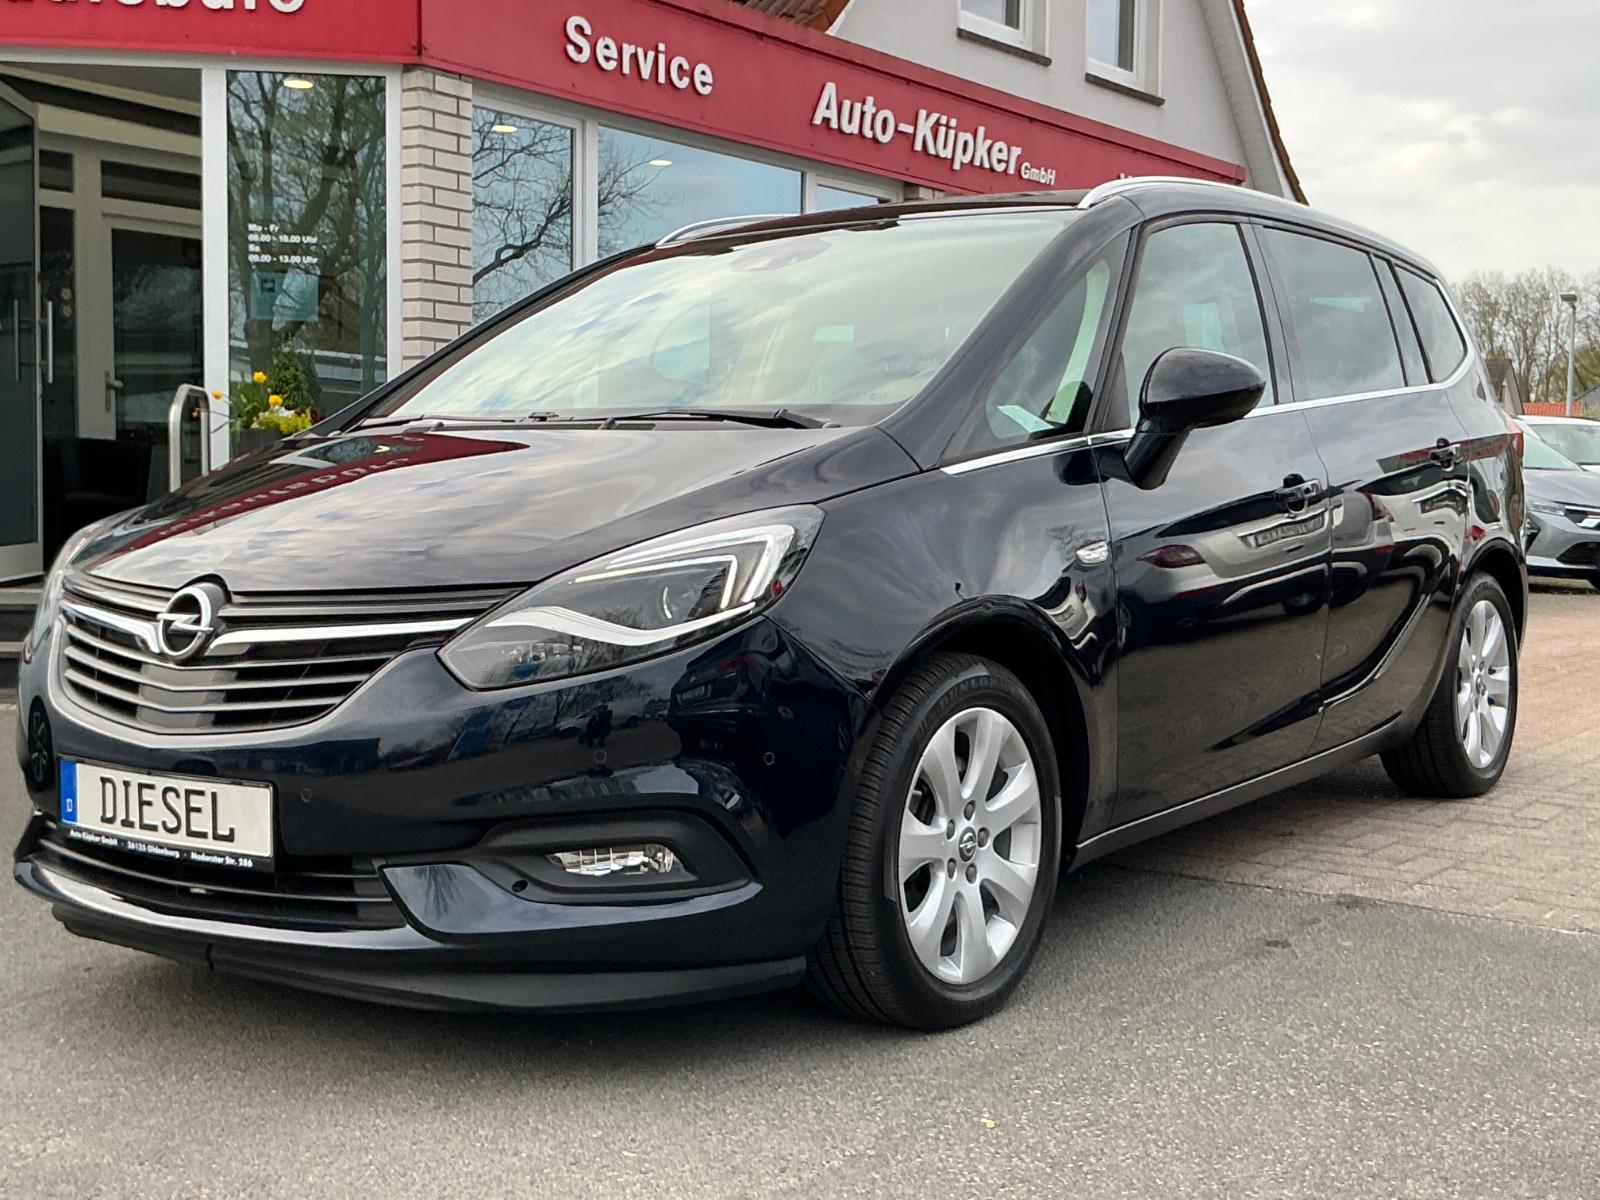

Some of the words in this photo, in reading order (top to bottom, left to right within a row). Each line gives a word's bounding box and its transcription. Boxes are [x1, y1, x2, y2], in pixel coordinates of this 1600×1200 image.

[565, 15, 713, 95] Service
[812, 82, 1022, 175] Auto-Küpker
[1020, 162, 1056, 186] GmbH
[301, 235, 318, 244] Uhr
[302, 255, 319, 264] Uhr
[66, 798, 73, 812] D
[99, 776, 236, 843] DIESEL
